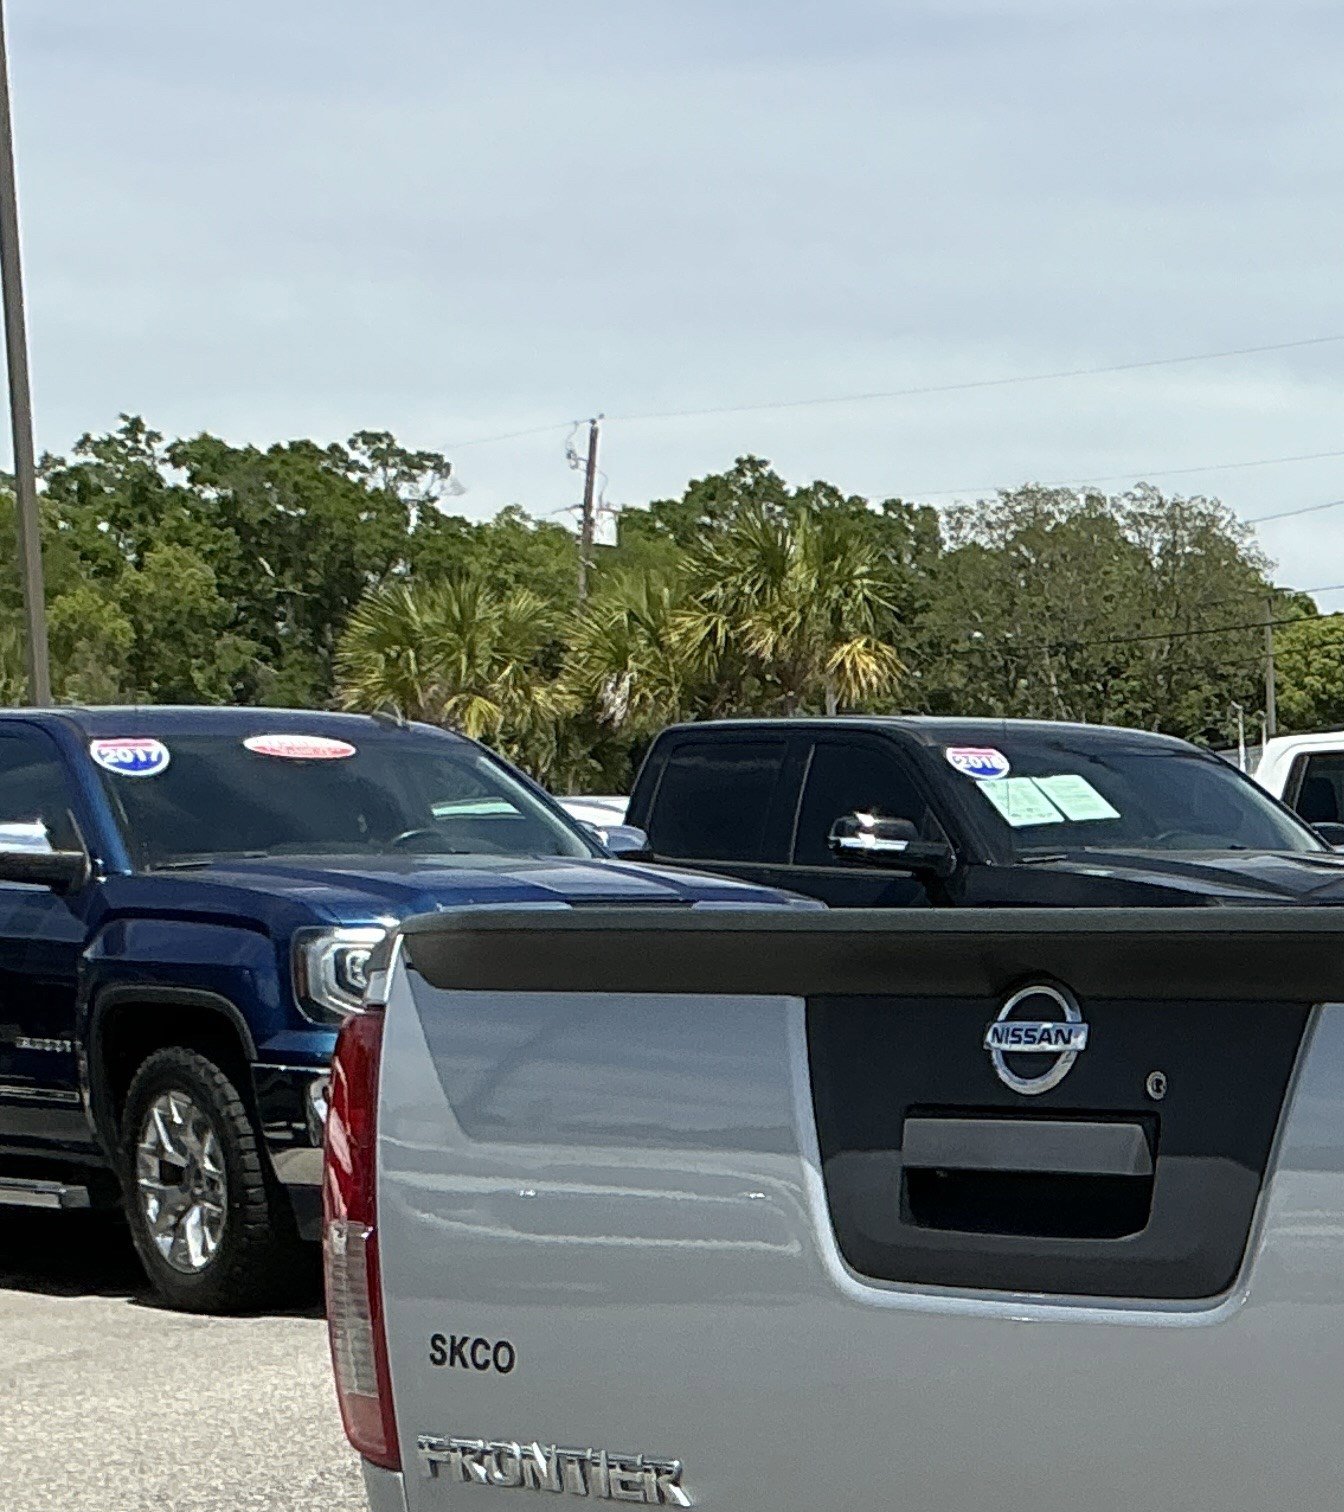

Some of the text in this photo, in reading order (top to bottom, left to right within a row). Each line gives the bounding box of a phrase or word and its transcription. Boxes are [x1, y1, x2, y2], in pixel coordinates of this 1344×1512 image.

[97, 747, 161, 764] 2017
[990, 1026, 1074, 1046] NISSAN
[429, 1333, 516, 1374] SKCO
[416, 1434, 694, 1508] FRONTIER
